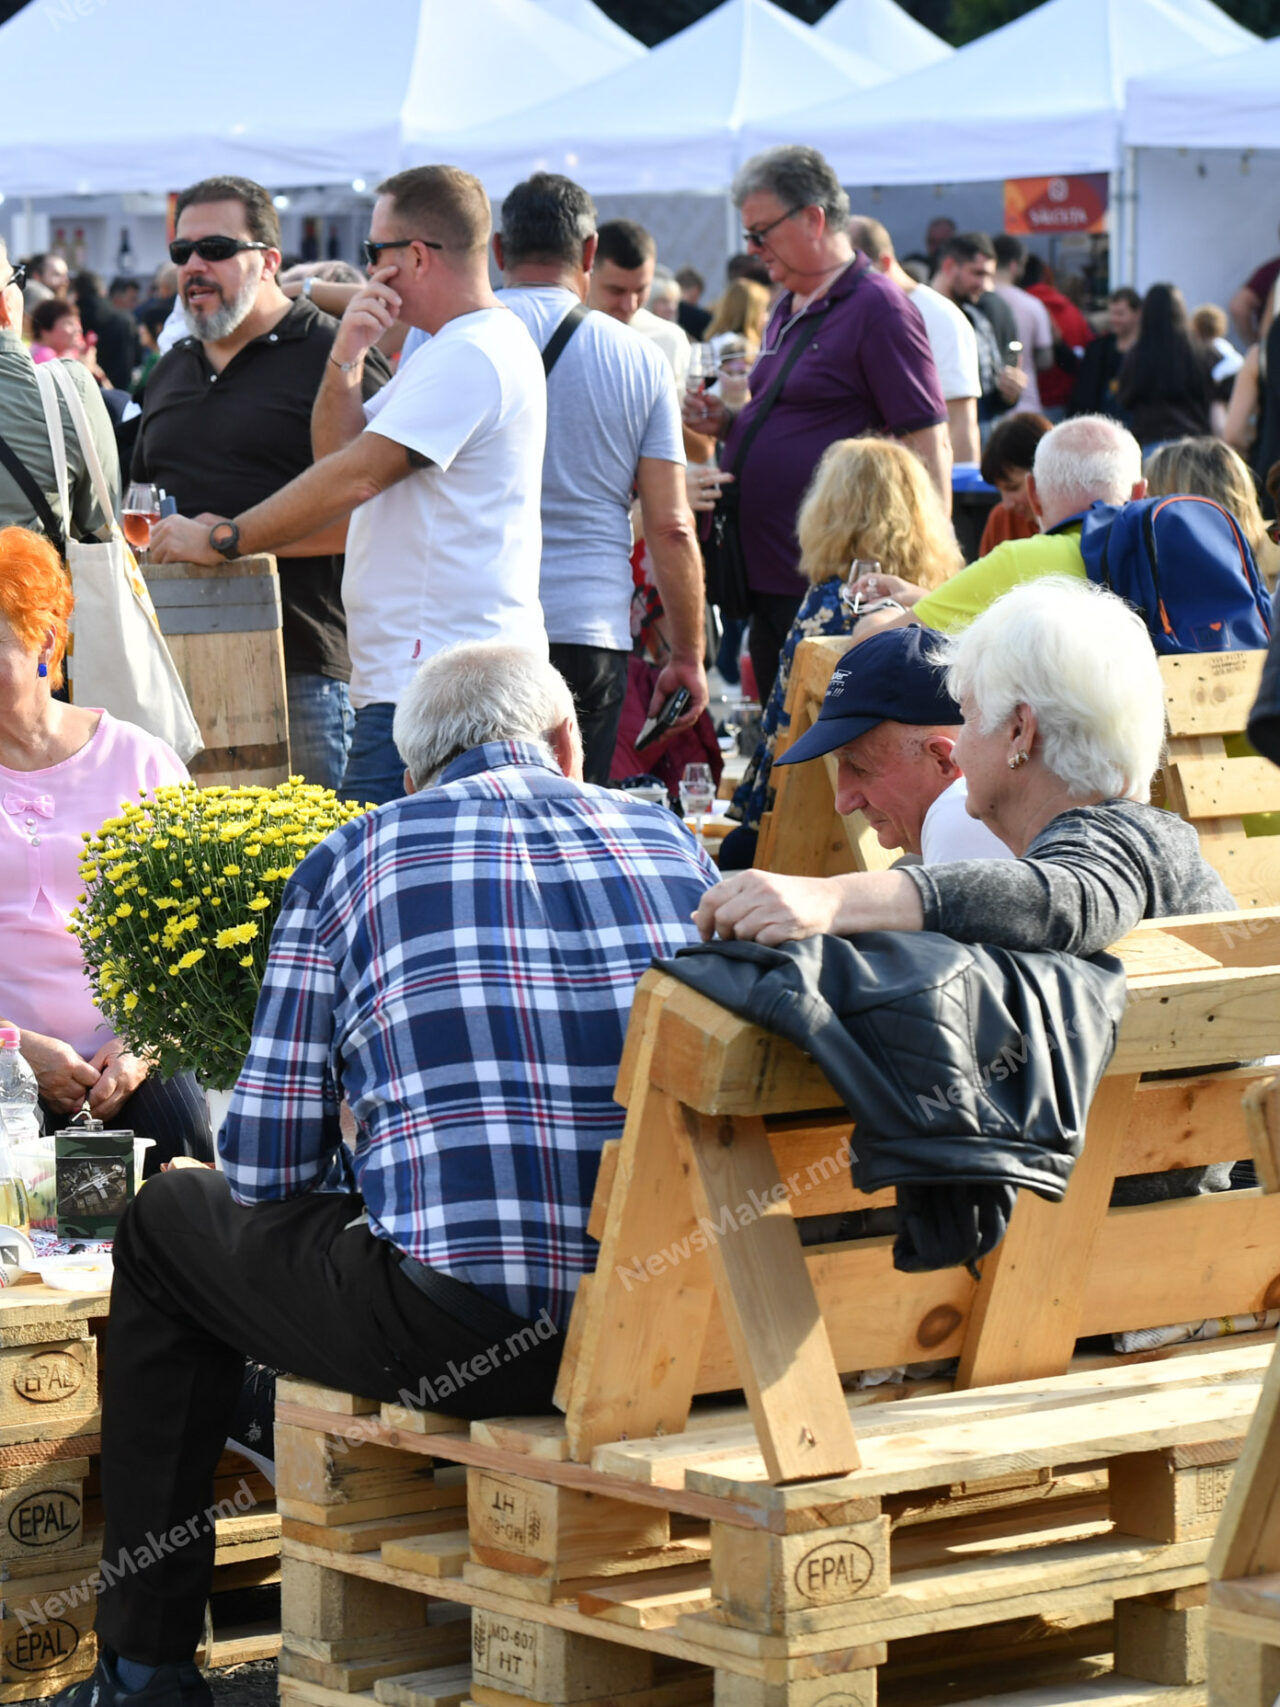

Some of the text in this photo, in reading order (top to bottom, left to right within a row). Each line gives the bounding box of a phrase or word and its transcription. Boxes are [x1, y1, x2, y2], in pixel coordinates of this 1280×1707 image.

[25, 1363, 74, 1392] EPAL
[19, 1500, 70, 1537] EPAL
[809, 1554, 863, 1591] EPAL
[16, 1628, 68, 1663] EPAL
[500, 1652, 522, 1674] HT
